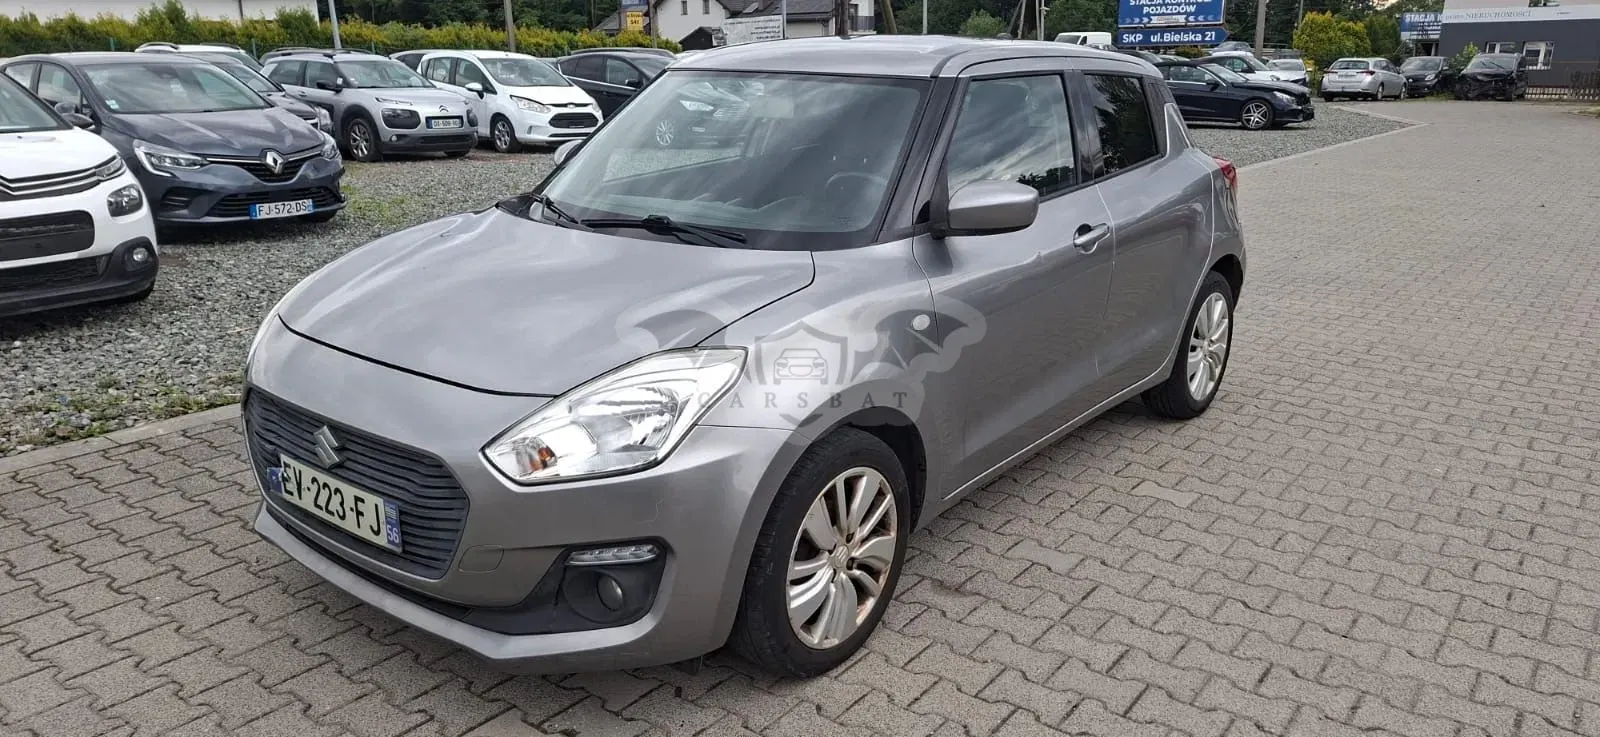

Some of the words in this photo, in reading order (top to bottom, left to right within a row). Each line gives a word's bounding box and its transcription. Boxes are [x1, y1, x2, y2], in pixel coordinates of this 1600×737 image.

[1143, 4, 1197, 14] POJAZDÓW
[1122, 33, 1143, 43] SKP
[1204, 31, 1216, 41] 21
[258, 201, 307, 217] FJ-572-DS
[282, 461, 381, 537] EV-223-FJ
[386, 525, 399, 544] 56
